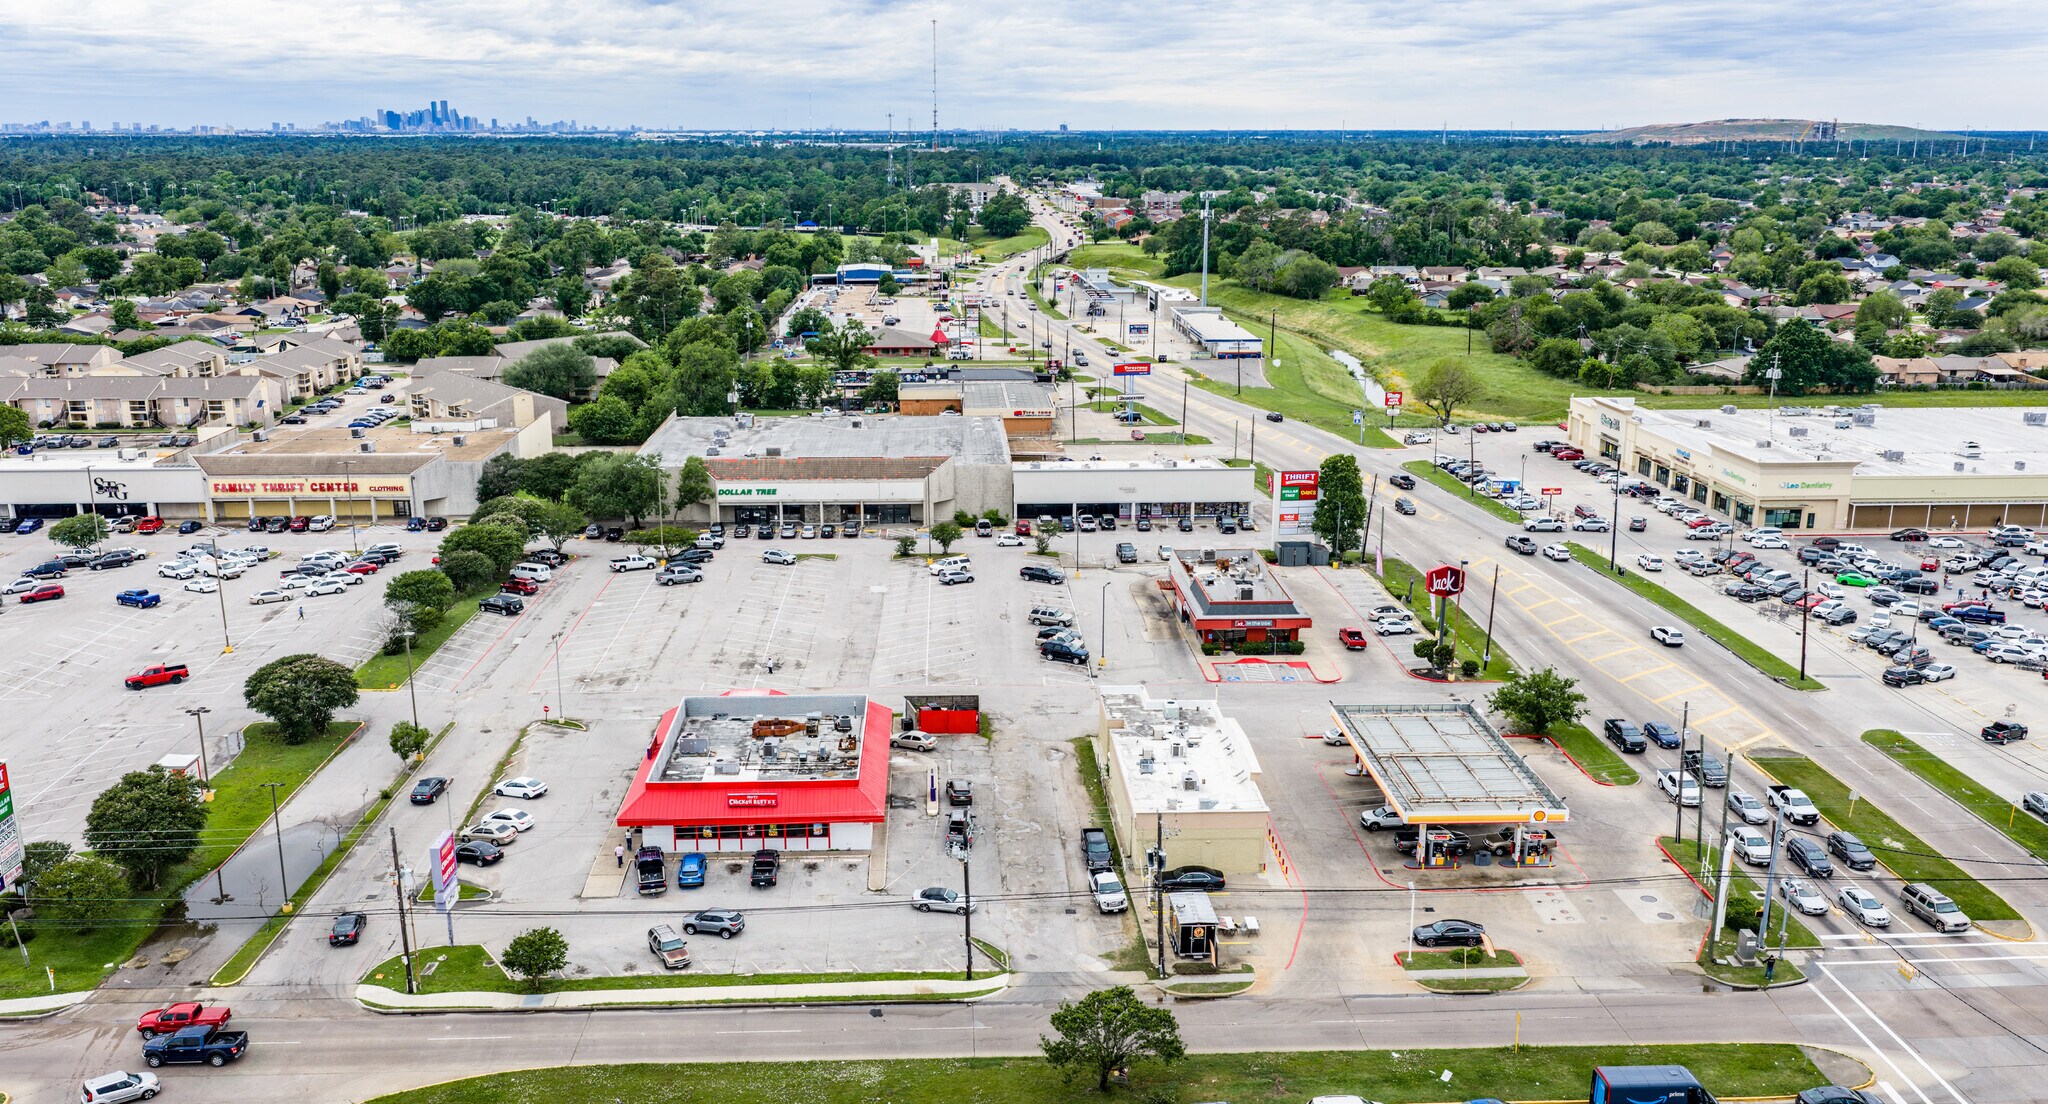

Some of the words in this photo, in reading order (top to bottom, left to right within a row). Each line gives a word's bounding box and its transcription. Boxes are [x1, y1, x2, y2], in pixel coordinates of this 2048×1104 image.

[213, 482, 256, 493] FAMILY
[262, 482, 305, 493] THRIFT
[310, 482, 359, 493] CENTER
[1801, 481, 1833, 490] Dentistry
[1430, 570, 1463, 592] Jack
